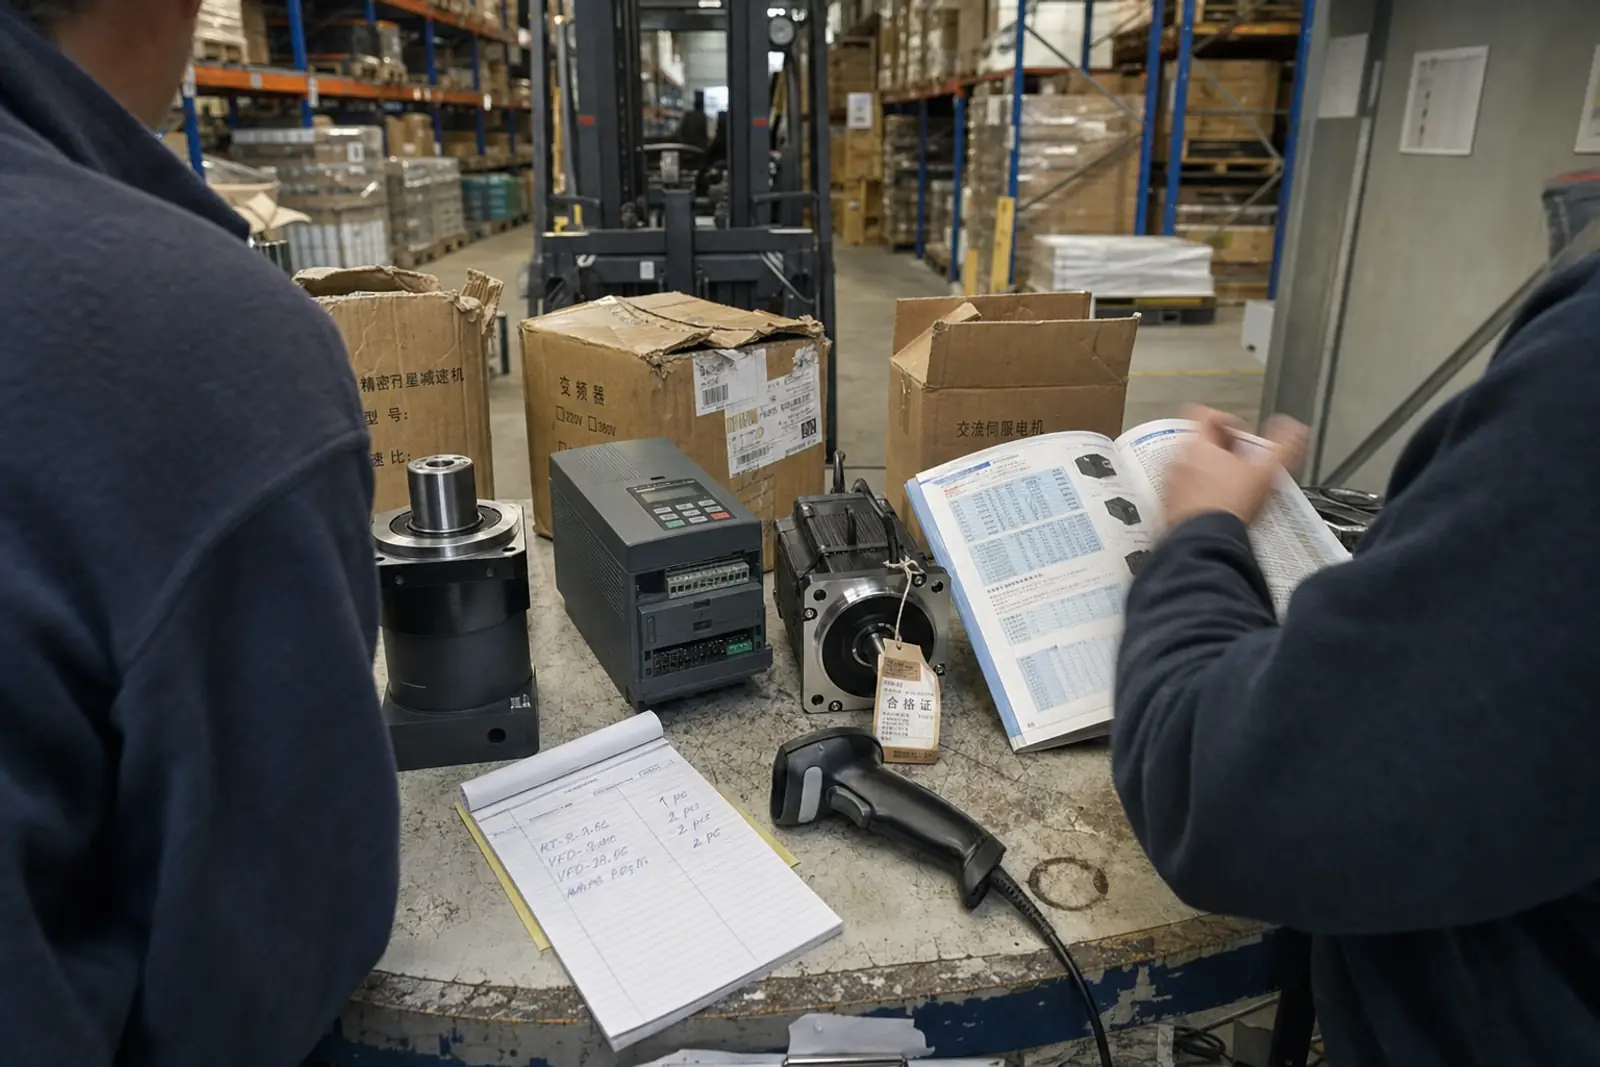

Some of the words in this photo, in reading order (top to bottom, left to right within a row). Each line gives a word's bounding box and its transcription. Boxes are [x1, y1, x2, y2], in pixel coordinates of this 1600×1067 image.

[559, 375, 606, 407] 变频器
[565, 410, 583, 427] 220V
[956, 419, 1045, 438] 交流伺服电机
[886, 695, 933, 712] 合格证
